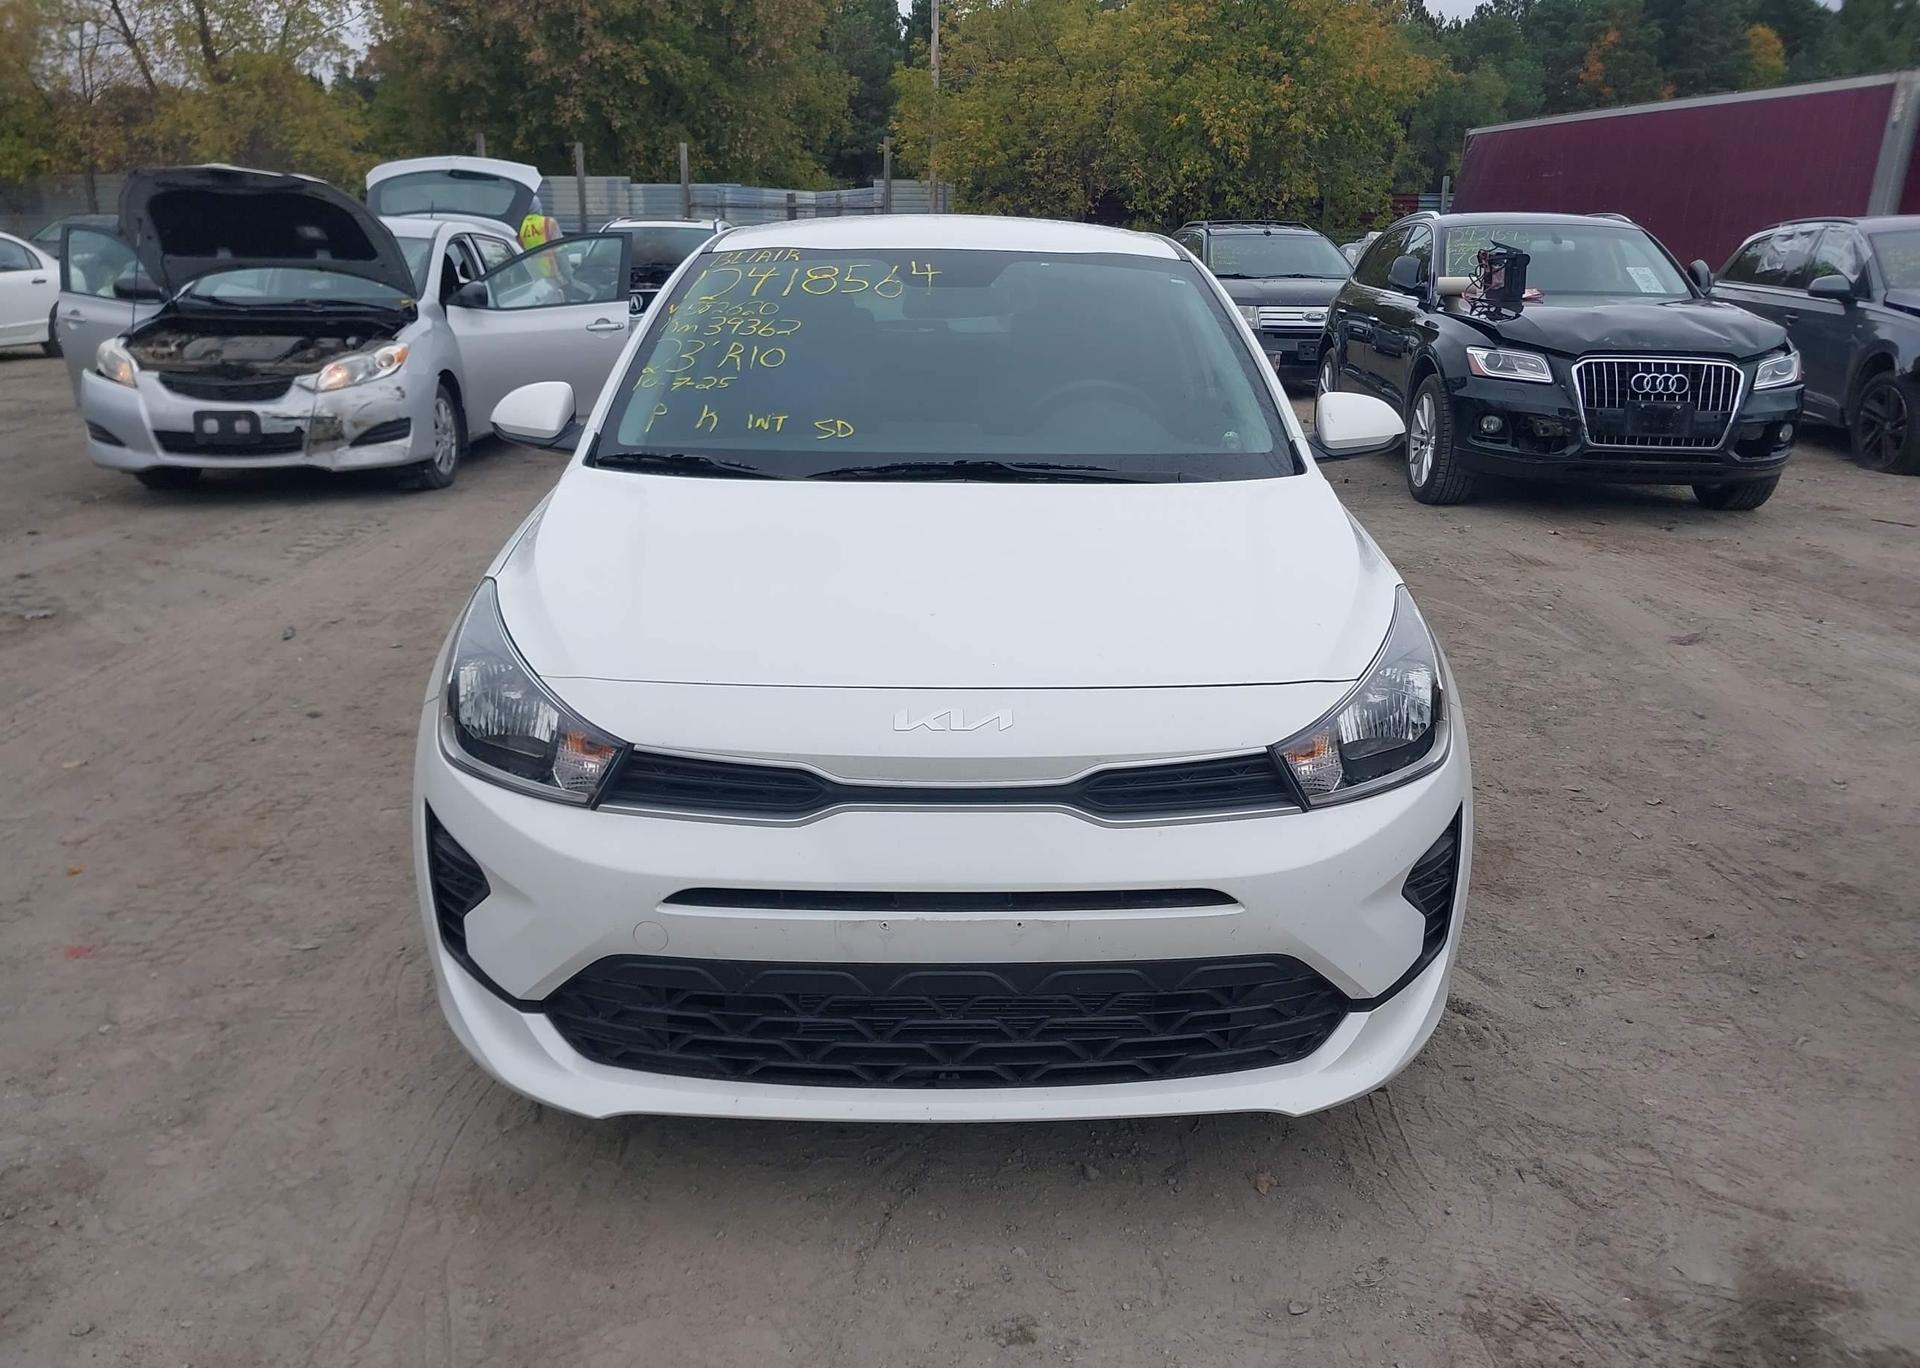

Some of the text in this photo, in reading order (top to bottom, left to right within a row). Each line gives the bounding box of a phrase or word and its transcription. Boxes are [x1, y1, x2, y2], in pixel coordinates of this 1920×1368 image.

[703, 316, 802, 338] 39362
[813, 418, 855, 440] SD
[893, 708, 1014, 732] KIA
